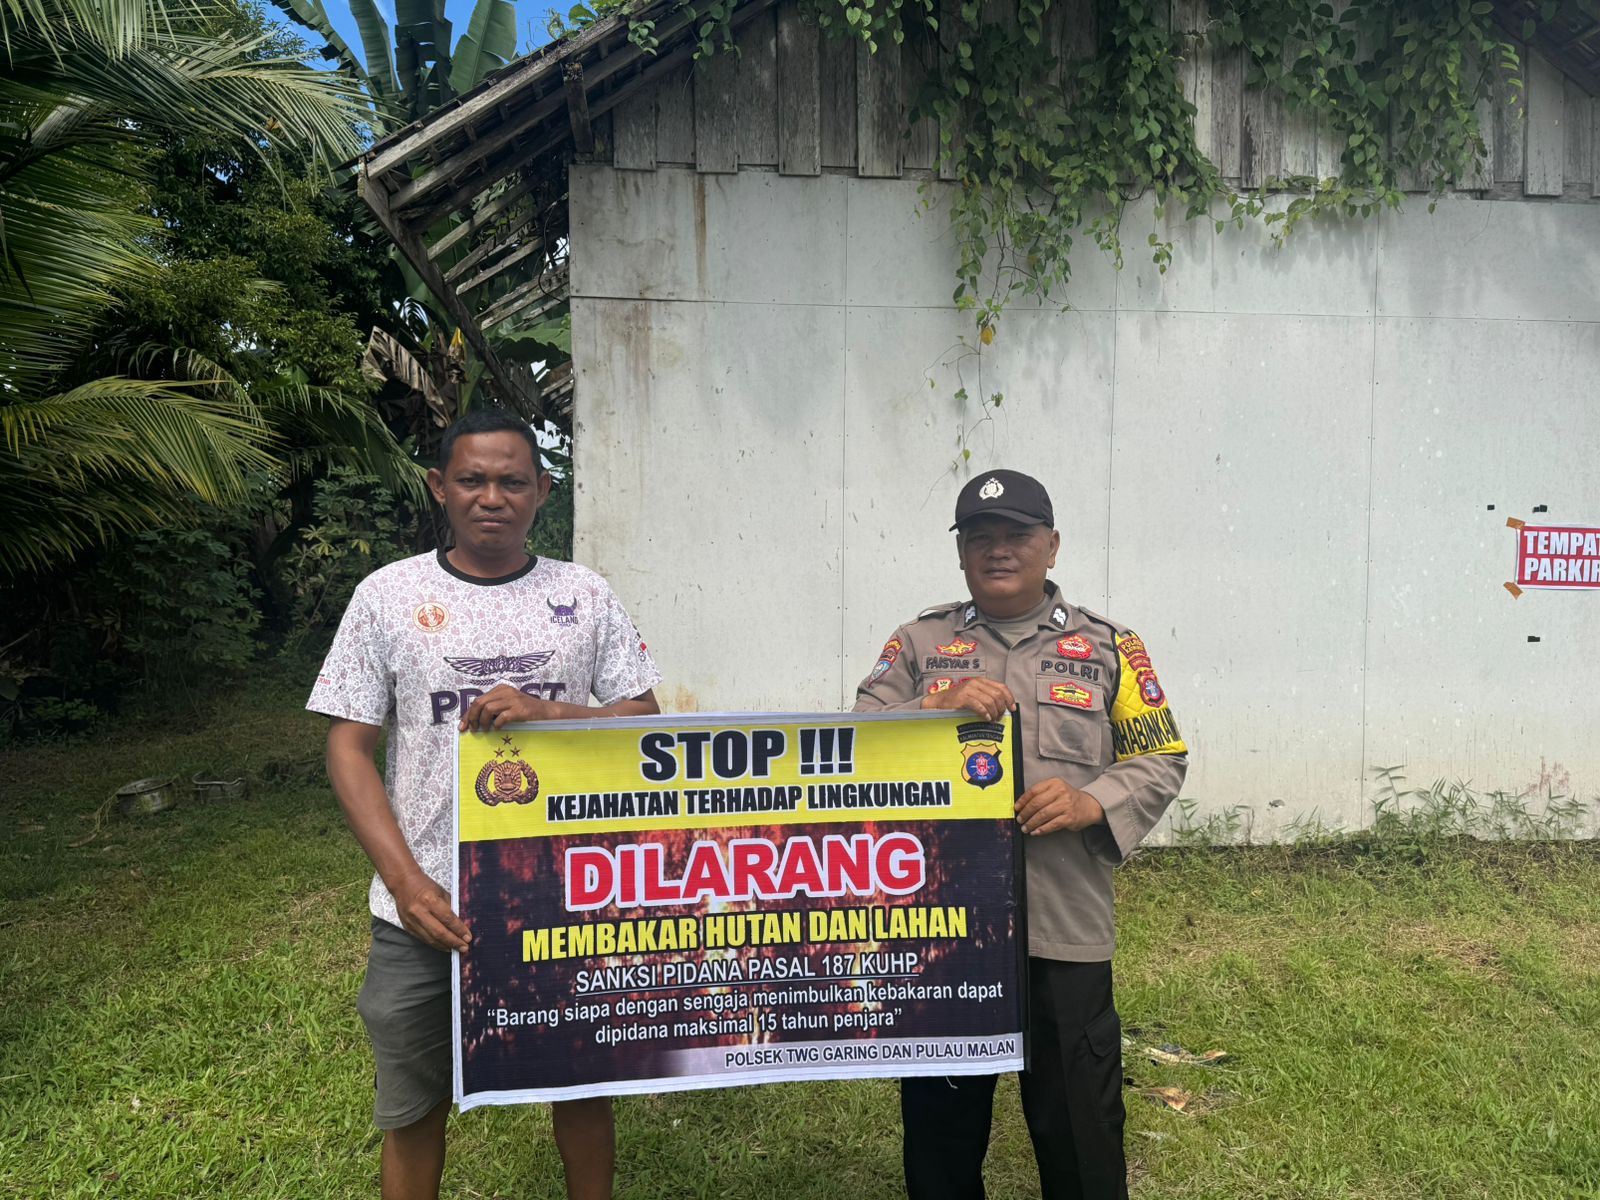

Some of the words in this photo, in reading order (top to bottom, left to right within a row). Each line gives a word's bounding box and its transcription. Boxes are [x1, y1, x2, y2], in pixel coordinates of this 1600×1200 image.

[550, 616, 578, 625] ICELAND
[972, 658, 980, 669] S
[1041, 660, 1099, 681] POLRI
[641, 730, 785, 781] STOP
[800, 727, 854, 775] !!!
[547, 790, 679, 821] KEJAHATAN
[684, 786, 802, 816] TERHADAP
[808, 781, 950, 809] LINGKUNGAN
[566, 834, 925, 910] DILARANG
[522, 917, 697, 962] MEMBAKAR
[706, 911, 801, 948] HUTAN
[809, 909, 867, 942] DAN
[876, 907, 967, 939] LAHAN
[576, 966, 656, 993] SANKSI
[663, 959, 741, 986] PIDANA
[748, 956, 815, 979] PASAL
[822, 954, 855, 976] 187
[862, 952, 918, 975] KUHP
[487, 1008, 559, 1027] “Barang
[564, 1002, 610, 1023] siapa
[616, 996, 678, 1018] dengan
[683, 992, 748, 1013] sengaja
[753, 984, 864, 1006] menimbulkan
[869, 982, 952, 1001] kebakaran
[958, 981, 1003, 1003] dapat
[595, 1023, 669, 1046] dipidana
[674, 1014, 752, 1036] maksimal
[758, 1014, 777, 1031] 15
[781, 1012, 829, 1030] tahun
[834, 1008, 902, 1032] penjara”
[725, 1048, 783, 1068] POLSEK
[787, 1047, 819, 1063] TWG
[823, 1045, 878, 1062] GARING
[883, 1044, 912, 1059] DAN
[916, 1042, 963, 1058] PULAU
[967, 1040, 1015, 1057] MALAN
